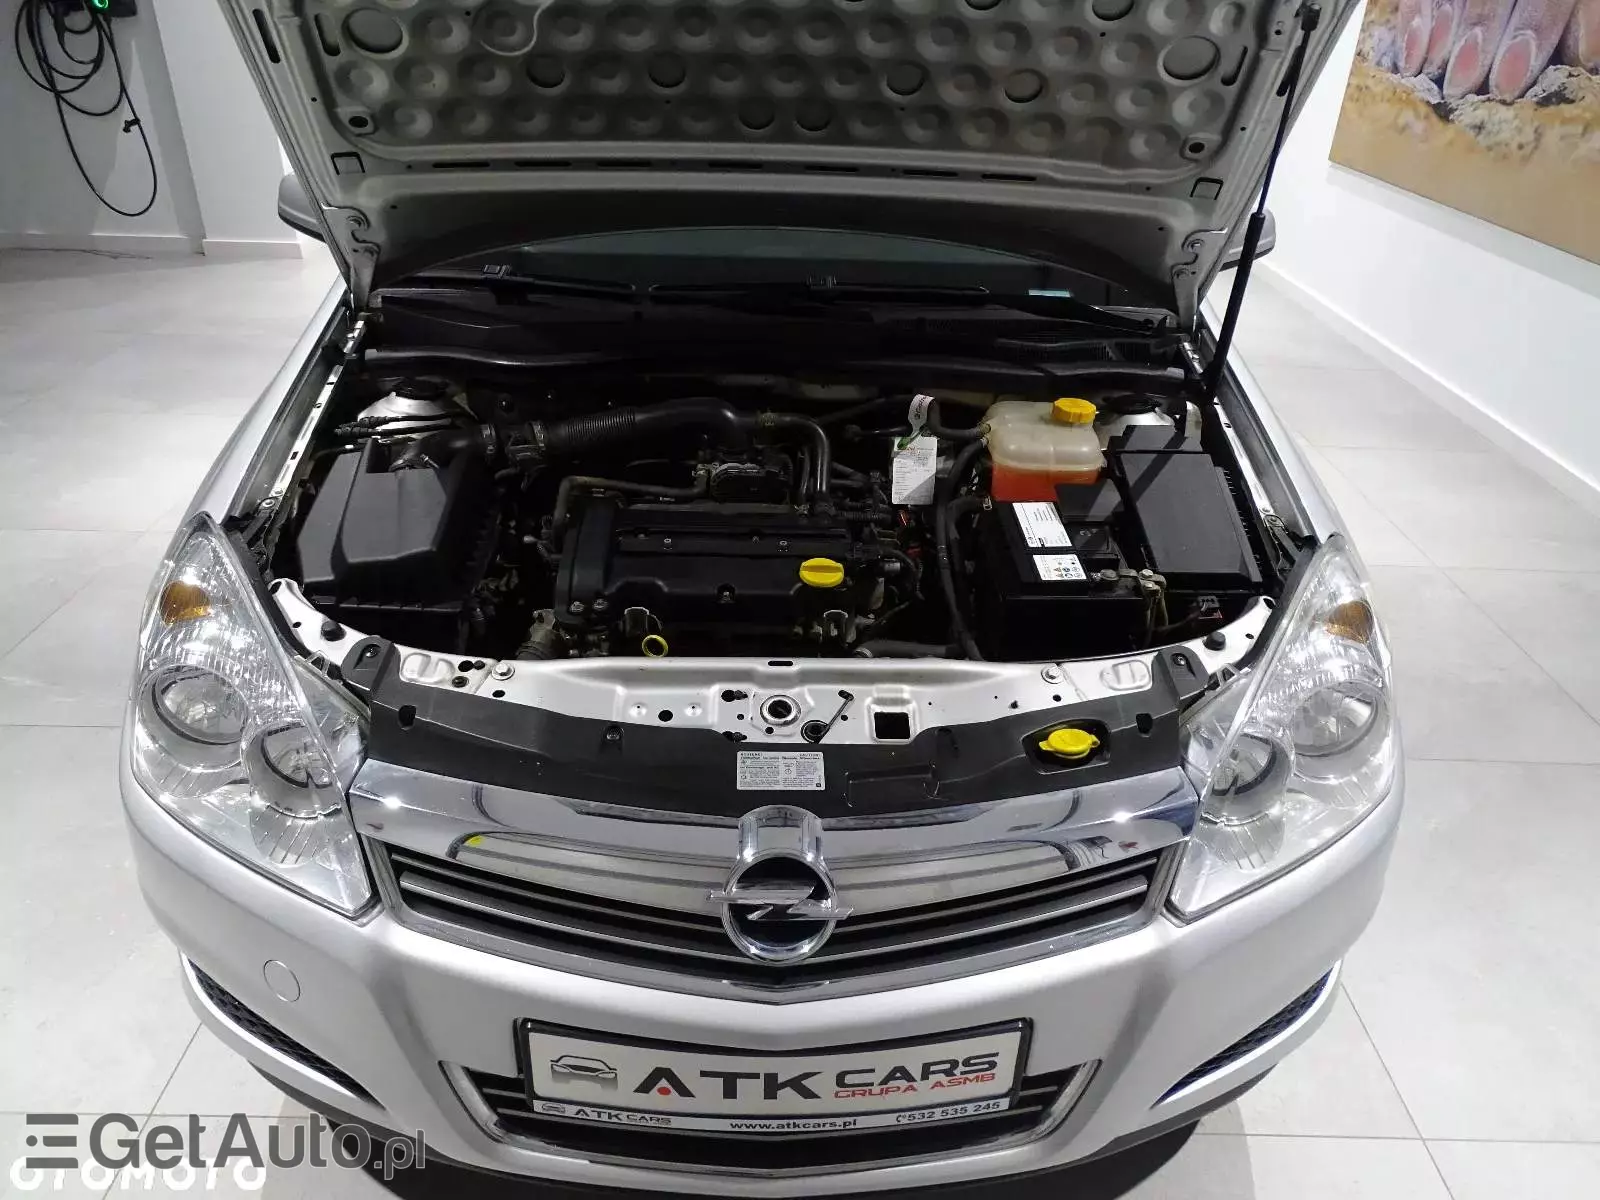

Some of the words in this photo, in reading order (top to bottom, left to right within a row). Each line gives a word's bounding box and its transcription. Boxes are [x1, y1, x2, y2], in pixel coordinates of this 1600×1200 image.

[633, 1066, 822, 1100] ATK
[836, 1052, 999, 1088] CARS
[834, 1084, 917, 1099] GRUPA
[930, 1072, 996, 1090] ASMB
[575, 1109, 622, 1121] ATK
[626, 1114, 672, 1124] CARS
[906, 1111, 936, 1123] 532
[940, 1106, 968, 1117] 535
[973, 1101, 1000, 1113] 245
[730, 1119, 857, 1129] www.atkcars.pl
